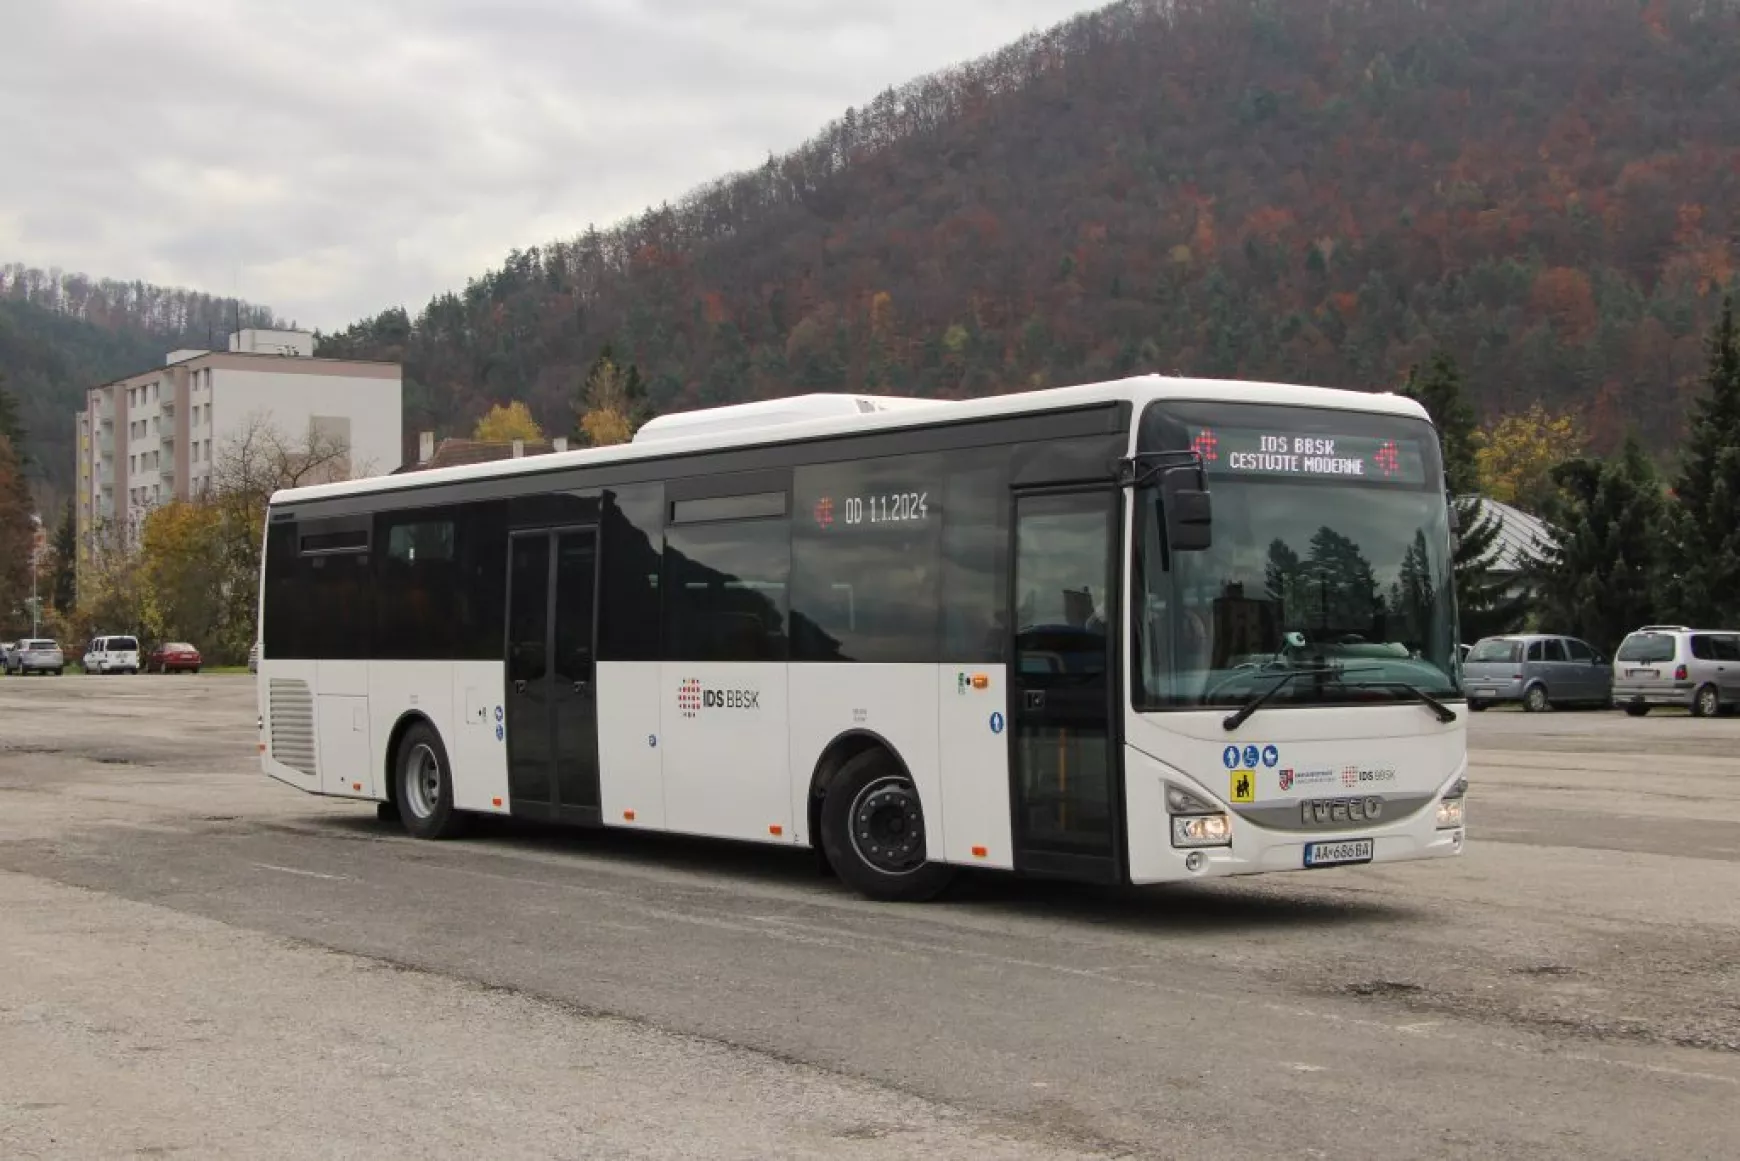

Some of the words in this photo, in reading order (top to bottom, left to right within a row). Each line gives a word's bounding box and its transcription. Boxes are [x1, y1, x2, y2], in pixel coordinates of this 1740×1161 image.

[1260, 435, 1287, 452] IDS
[1294, 438, 1334, 455] BBSK
[1229, 452, 1299, 472] CESTUJTE
[1304, 456, 1364, 475] MODERNE
[702, 689, 724, 707] IDS
[726, 689, 759, 708] BBSK
[1359, 771, 1373, 781] IDS
[1301, 795, 1382, 825] IVECO
